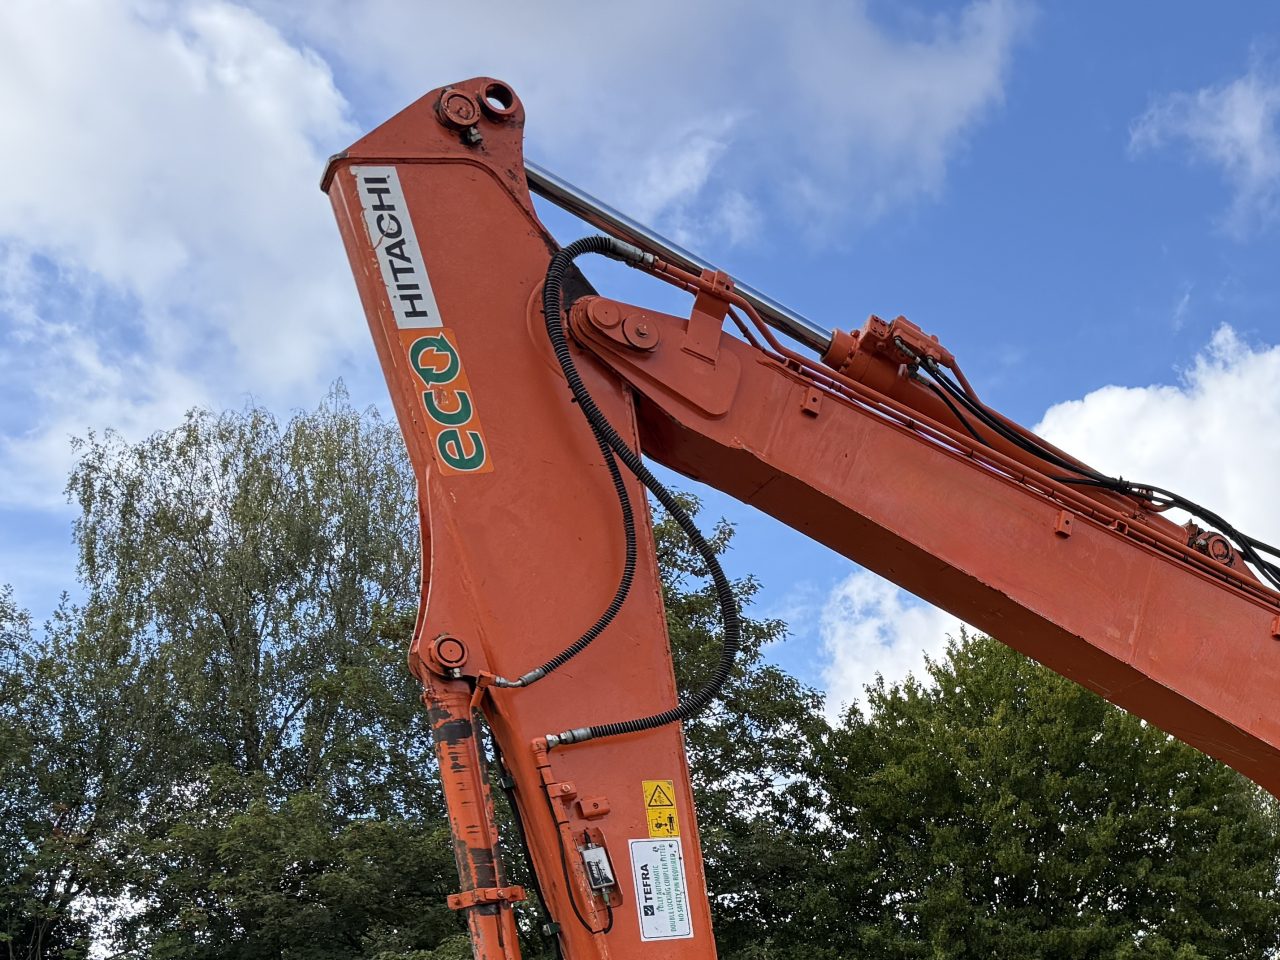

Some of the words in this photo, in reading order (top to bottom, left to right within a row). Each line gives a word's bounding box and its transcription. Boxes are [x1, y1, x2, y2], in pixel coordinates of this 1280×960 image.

[364, 177, 428, 318] HITACHI
[408, 332, 486, 471] eco
[659, 844, 667, 862] FITTED
[641, 864, 653, 903] TEFRA
[653, 865, 662, 895] AUTOMATIC
[662, 863, 670, 886] COUPLER
[665, 887, 673, 910] LOCKING
[675, 892, 683, 912] SAFETY
[668, 911, 676, 931] DOUBLE
